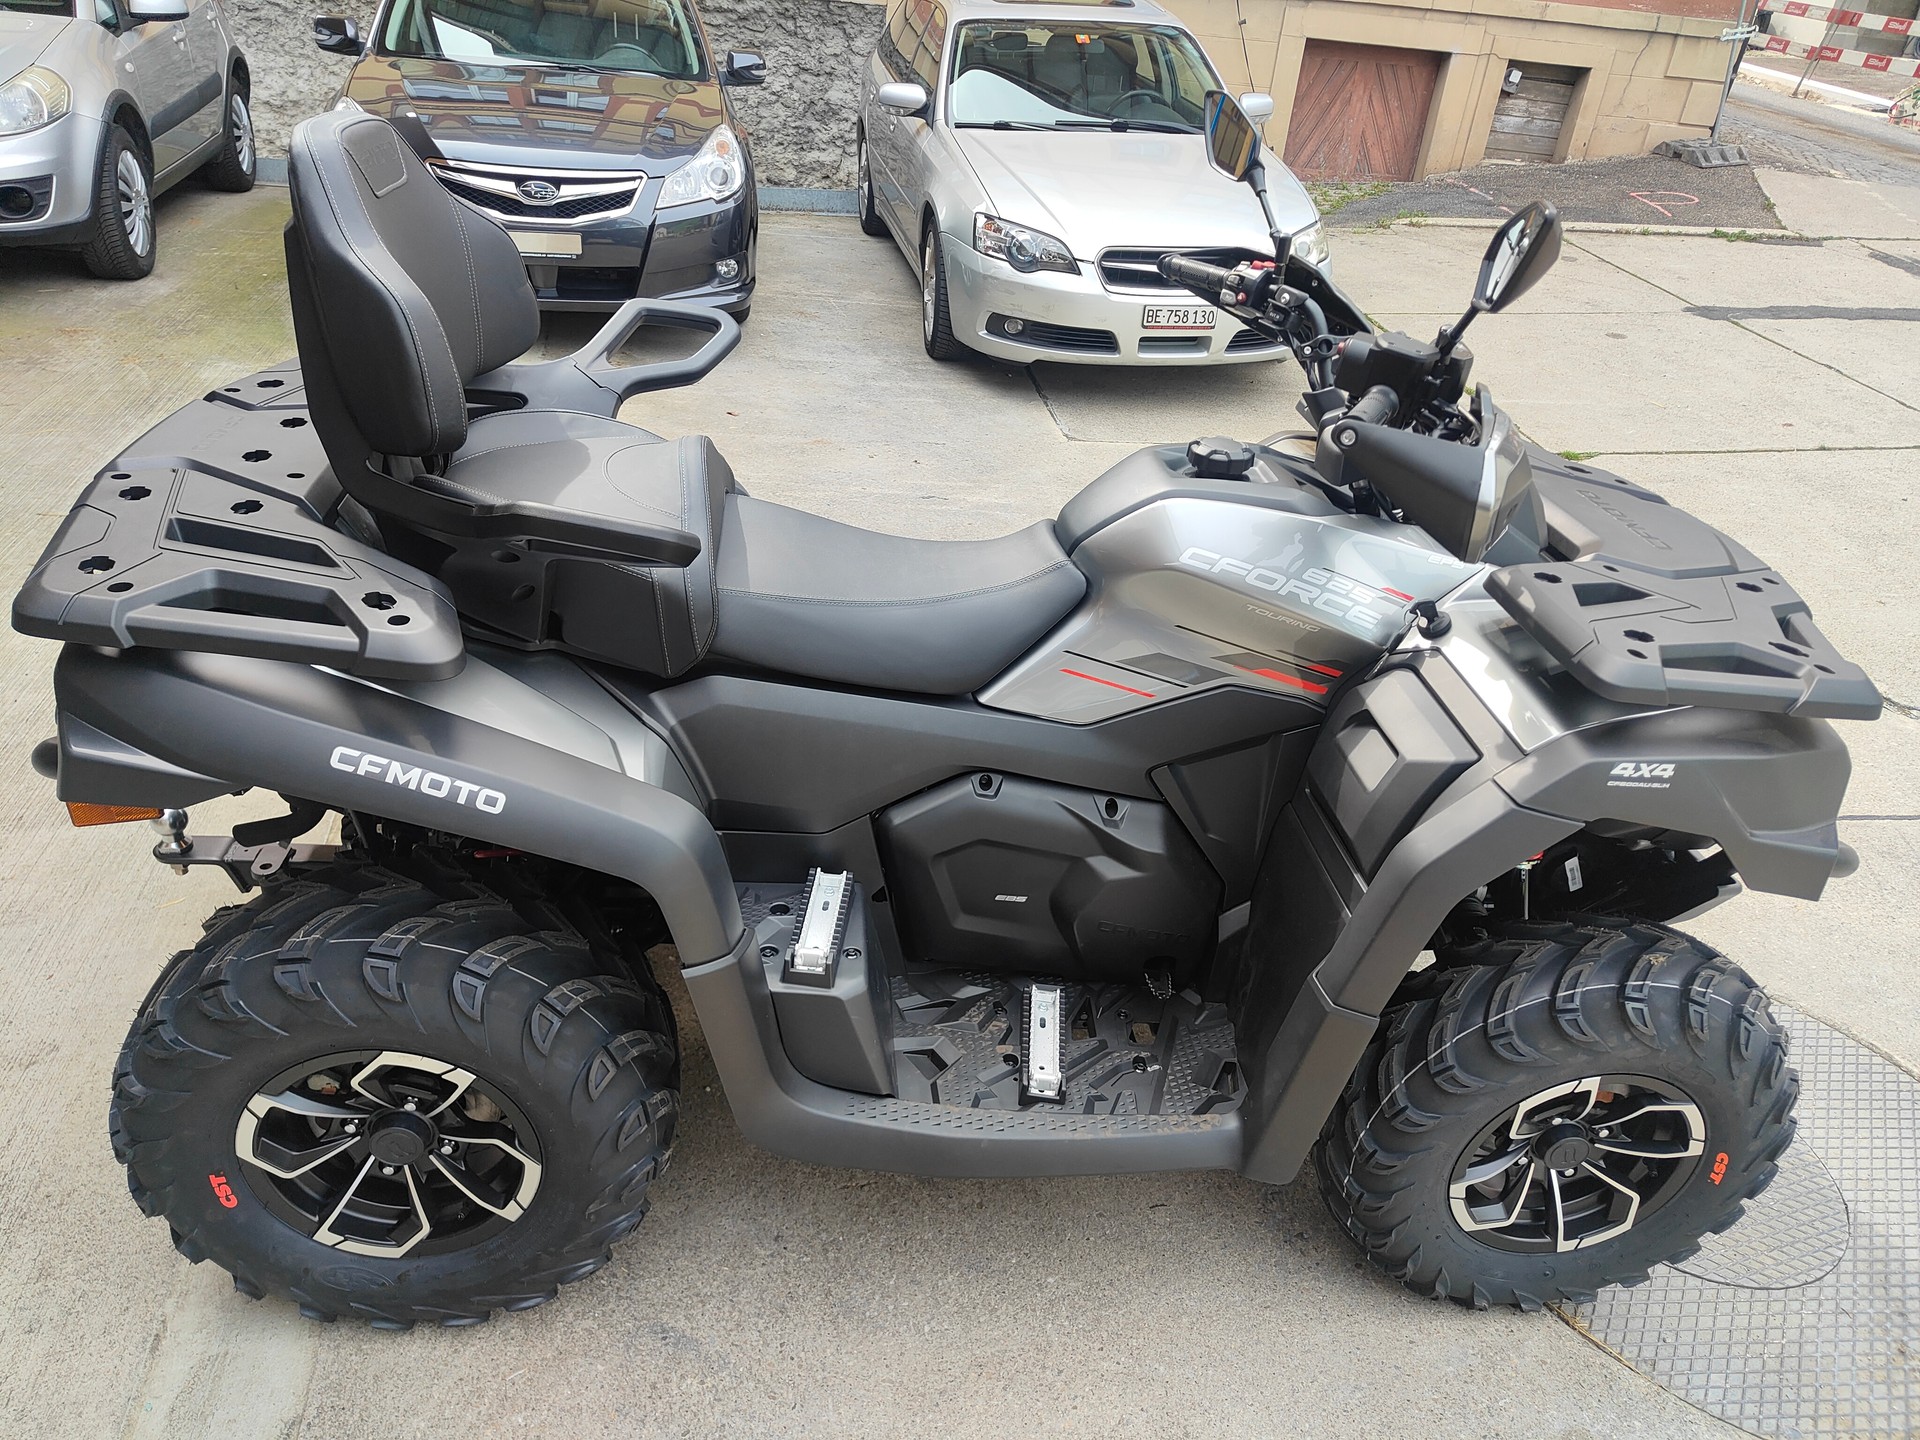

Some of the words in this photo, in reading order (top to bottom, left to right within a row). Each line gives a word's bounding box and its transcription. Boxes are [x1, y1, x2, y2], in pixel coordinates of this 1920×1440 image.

[1192, 309, 1215, 324] 130
[1178, 546, 1383, 630] CFORCE
[1302, 567, 1377, 605] 625
[1246, 604, 1321, 632] TOURING
[329, 745, 507, 815] CFMOTO
[1710, 1152, 1729, 1186] CST
[208, 1174, 238, 1209] CST
